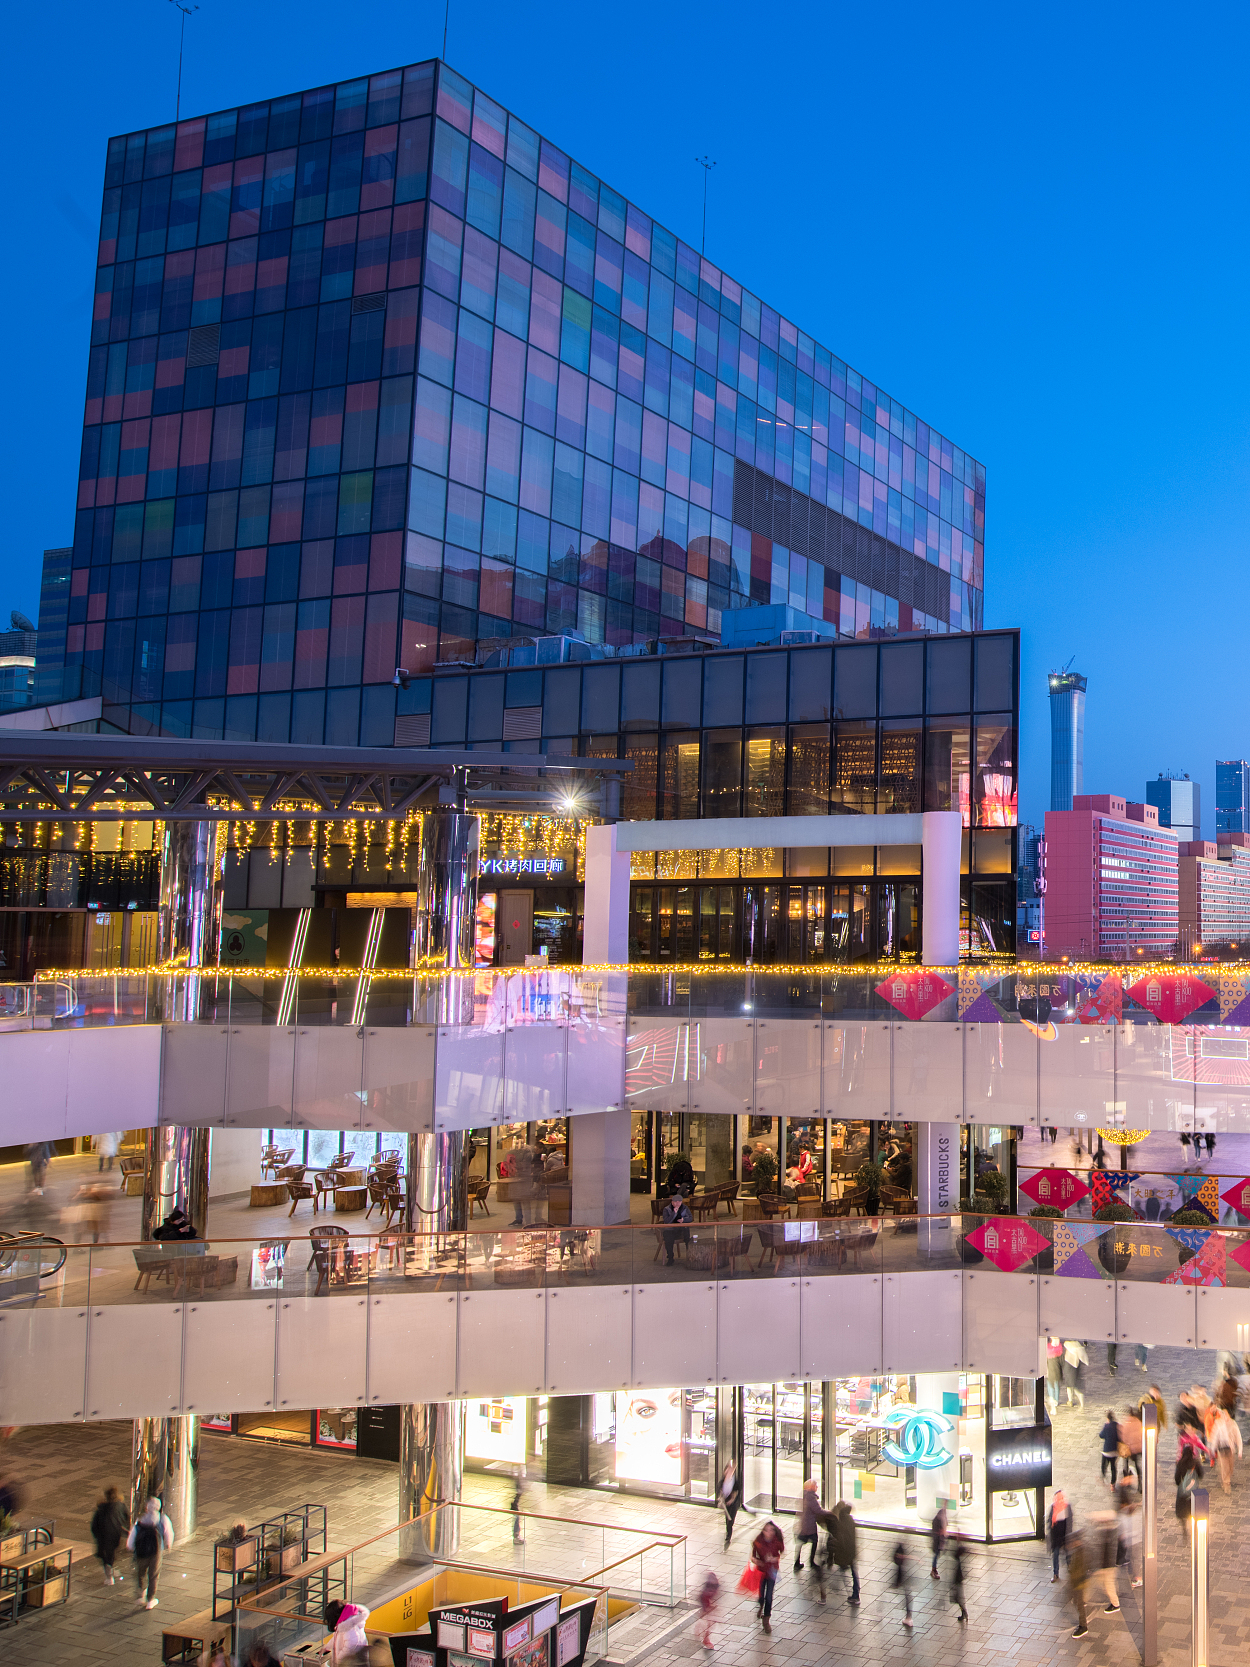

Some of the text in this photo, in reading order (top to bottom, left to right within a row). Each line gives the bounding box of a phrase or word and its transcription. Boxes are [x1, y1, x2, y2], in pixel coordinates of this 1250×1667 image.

[938, 1137, 949, 1208] STARBUCKS
[992, 1450, 1051, 1467] CHANEL
[404, 1595, 412, 1607] L1
[403, 1607, 413, 1620] LG
[440, 1611, 494, 1630] MEGABOX
